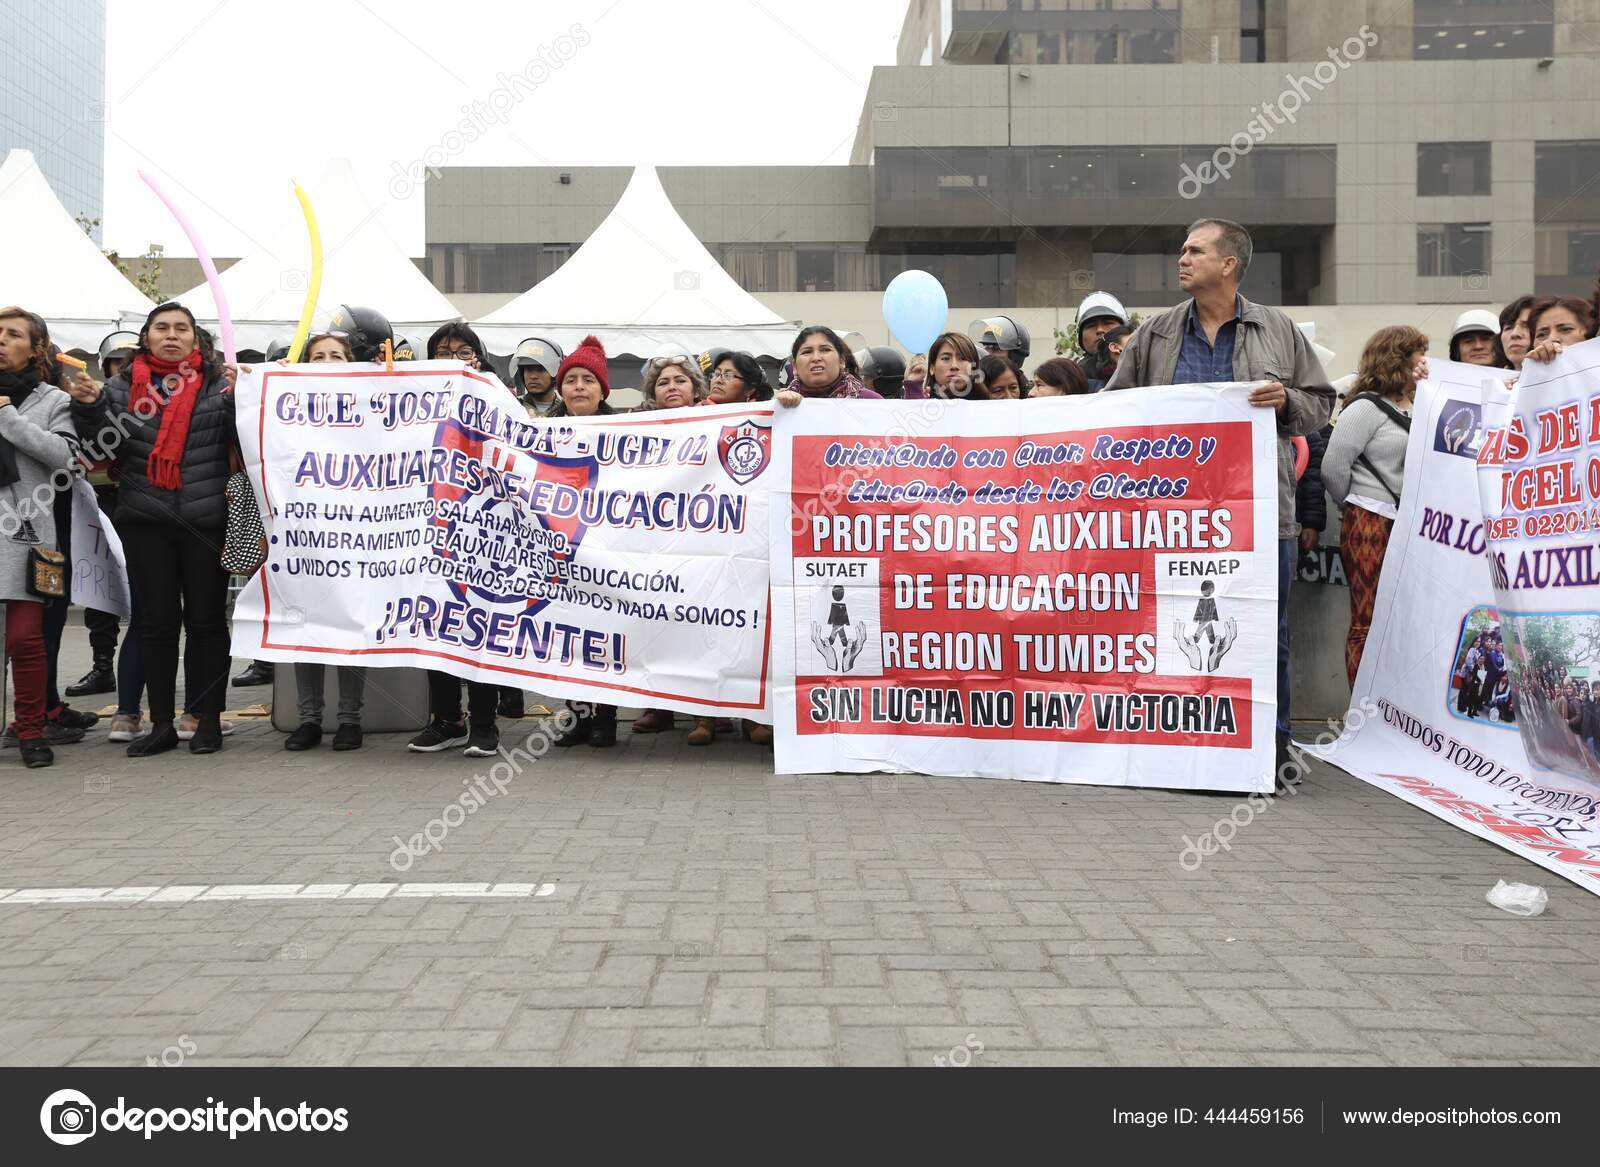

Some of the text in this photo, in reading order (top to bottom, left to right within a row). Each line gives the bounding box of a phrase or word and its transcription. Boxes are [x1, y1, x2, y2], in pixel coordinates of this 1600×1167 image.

[275, 391, 364, 427] G.U.E.
[596, 431, 672, 467] UGEL
[676, 433, 708, 466] 02
[1538, 403, 1582, 456] DE
[824, 442, 957, 469] Orient@ndo
[963, 446, 1006, 468] con
[1092, 434, 1193, 464] Respeto
[1196, 436, 1216, 464] y
[295, 450, 485, 494] AUXILIARES
[529, 481, 747, 533] EDUCACIÓN
[848, 473, 1189, 505] Educ@ndo desde los @fectos
[285, 502, 317, 521] POR
[323, 503, 354, 522] UN
[359, 499, 434, 523] AUMENTO
[437, 500, 518, 536] SALARIAL
[812, 507, 1234, 553] PROFESORES AUXILIARES
[1419, 507, 1451, 546] POR
[285, 527, 685, 594] NOMBRAMIENTO DE AUXILIARES DE EDUCACIÓN.
[805, 562, 868, 578] SUTAET
[1168, 559, 1241, 577] FENAEP
[286, 557, 352, 578] UNIDOS
[359, 557, 397, 579] TODO
[399, 556, 417, 576] LO
[513, 577, 613, 611] DESUNIDOS
[617, 603, 669, 622] NADA
[674, 605, 746, 629] SOMOS
[893, 572, 1141, 612] DE EDUCACION
[375, 595, 627, 673] ¡PRESENTE!
[880, 631, 1158, 674] REGION TUMBES
[809, 686, 1238, 736] SIN LUCHA NO HAY VICTORIA
[1446, 740, 1495, 778] TODO
